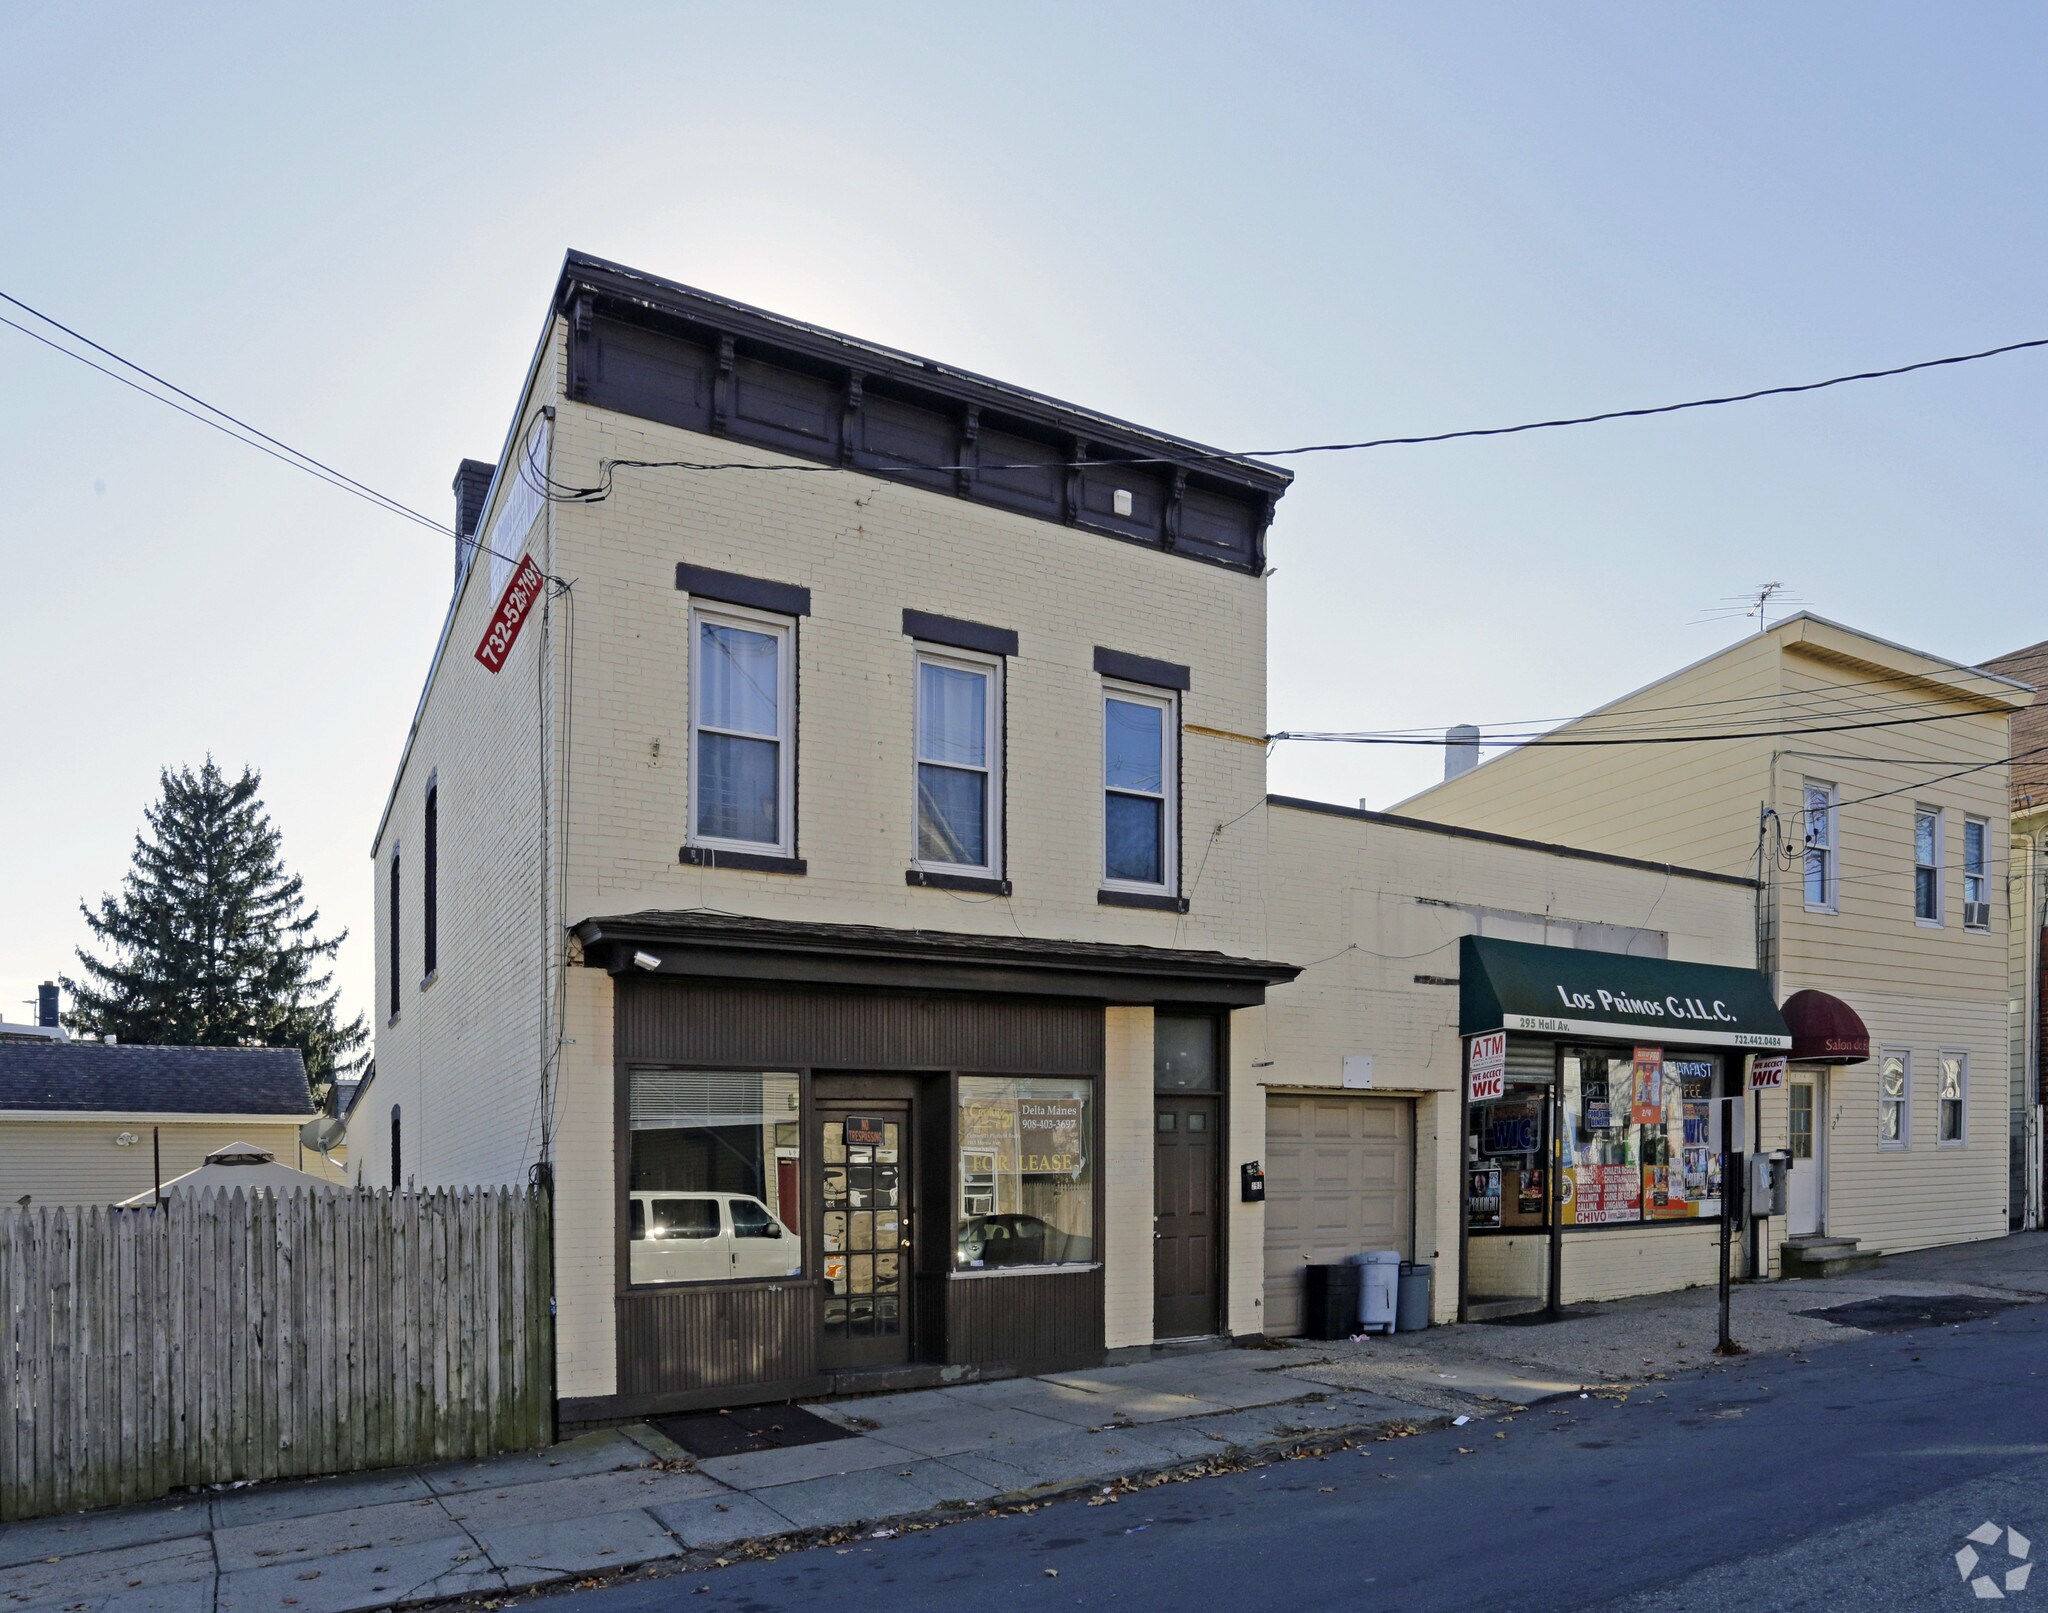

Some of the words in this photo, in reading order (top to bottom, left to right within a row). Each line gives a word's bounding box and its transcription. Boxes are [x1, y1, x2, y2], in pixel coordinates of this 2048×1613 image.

[1520, 1017, 1536, 1029] 295
[1538, 1018, 1555, 1030] Hall
[1557, 1020, 1570, 1031] Av.
[1472, 1034, 1504, 1060] ATM
[1734, 1035, 1781, 1047] 732.442.0484
[1825, 1038, 1852, 1051] Salon
[1754, 1061, 1763, 1070] WE
[1472, 1072, 1482, 1081] WE
[1752, 1069, 1782, 1087] WIC
[1472, 1078, 1501, 1097] WIC
[1022, 1104, 1045, 1116] Delta
[1047, 1104, 1077, 1116] Manes
[861, 1119, 870, 1131] NO
[1022, 1119, 1077, 1130] 908-403-3697
[1684, 1118, 1709, 1144] WIC
[848, 1129, 883, 1143] TRESPASSING
[1492, 1118, 1531, 1149] WIC
[972, 1154, 1010, 1172] FOR
[1018, 1154, 1073, 1171] LEASE
[1576, 1211, 1607, 1223] CHIVO
